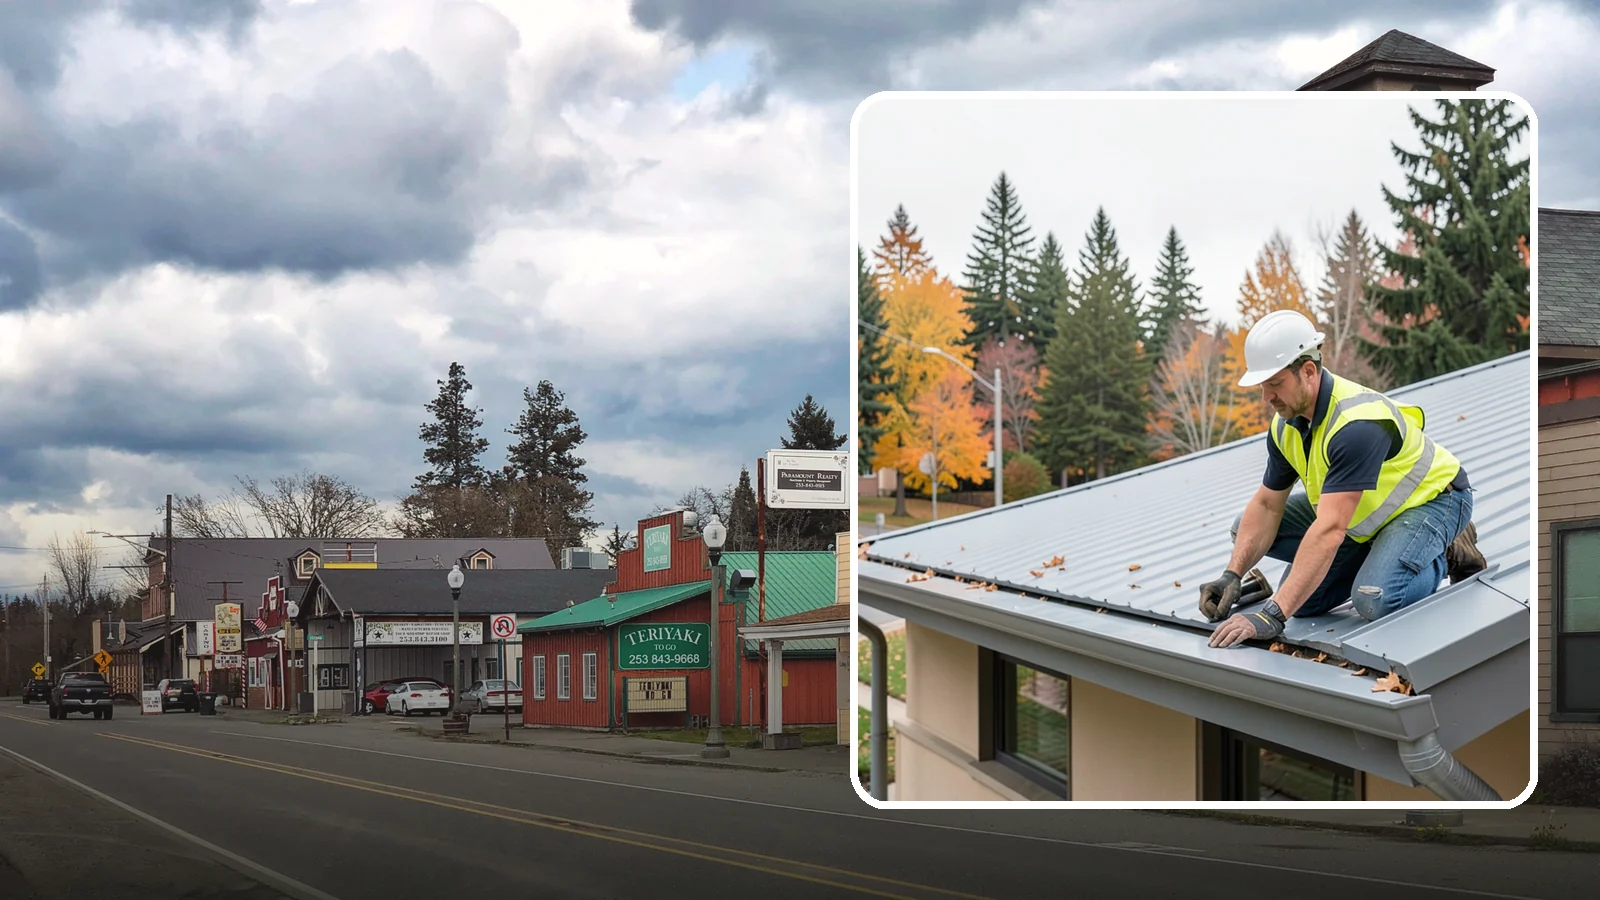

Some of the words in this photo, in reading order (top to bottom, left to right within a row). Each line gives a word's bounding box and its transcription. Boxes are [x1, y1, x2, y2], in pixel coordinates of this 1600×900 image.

[781, 471, 815, 479] PARAMOUNT
[817, 472, 839, 480] REALTY
[646, 531, 669, 548] TERIYAKI
[202, 624, 210, 649] CASINO
[624, 627, 702, 646] TERIYAKI
[629, 654, 649, 664] 253
[651, 653, 700, 664] 843-9668
[639, 681, 672, 691] TERIYAKI
